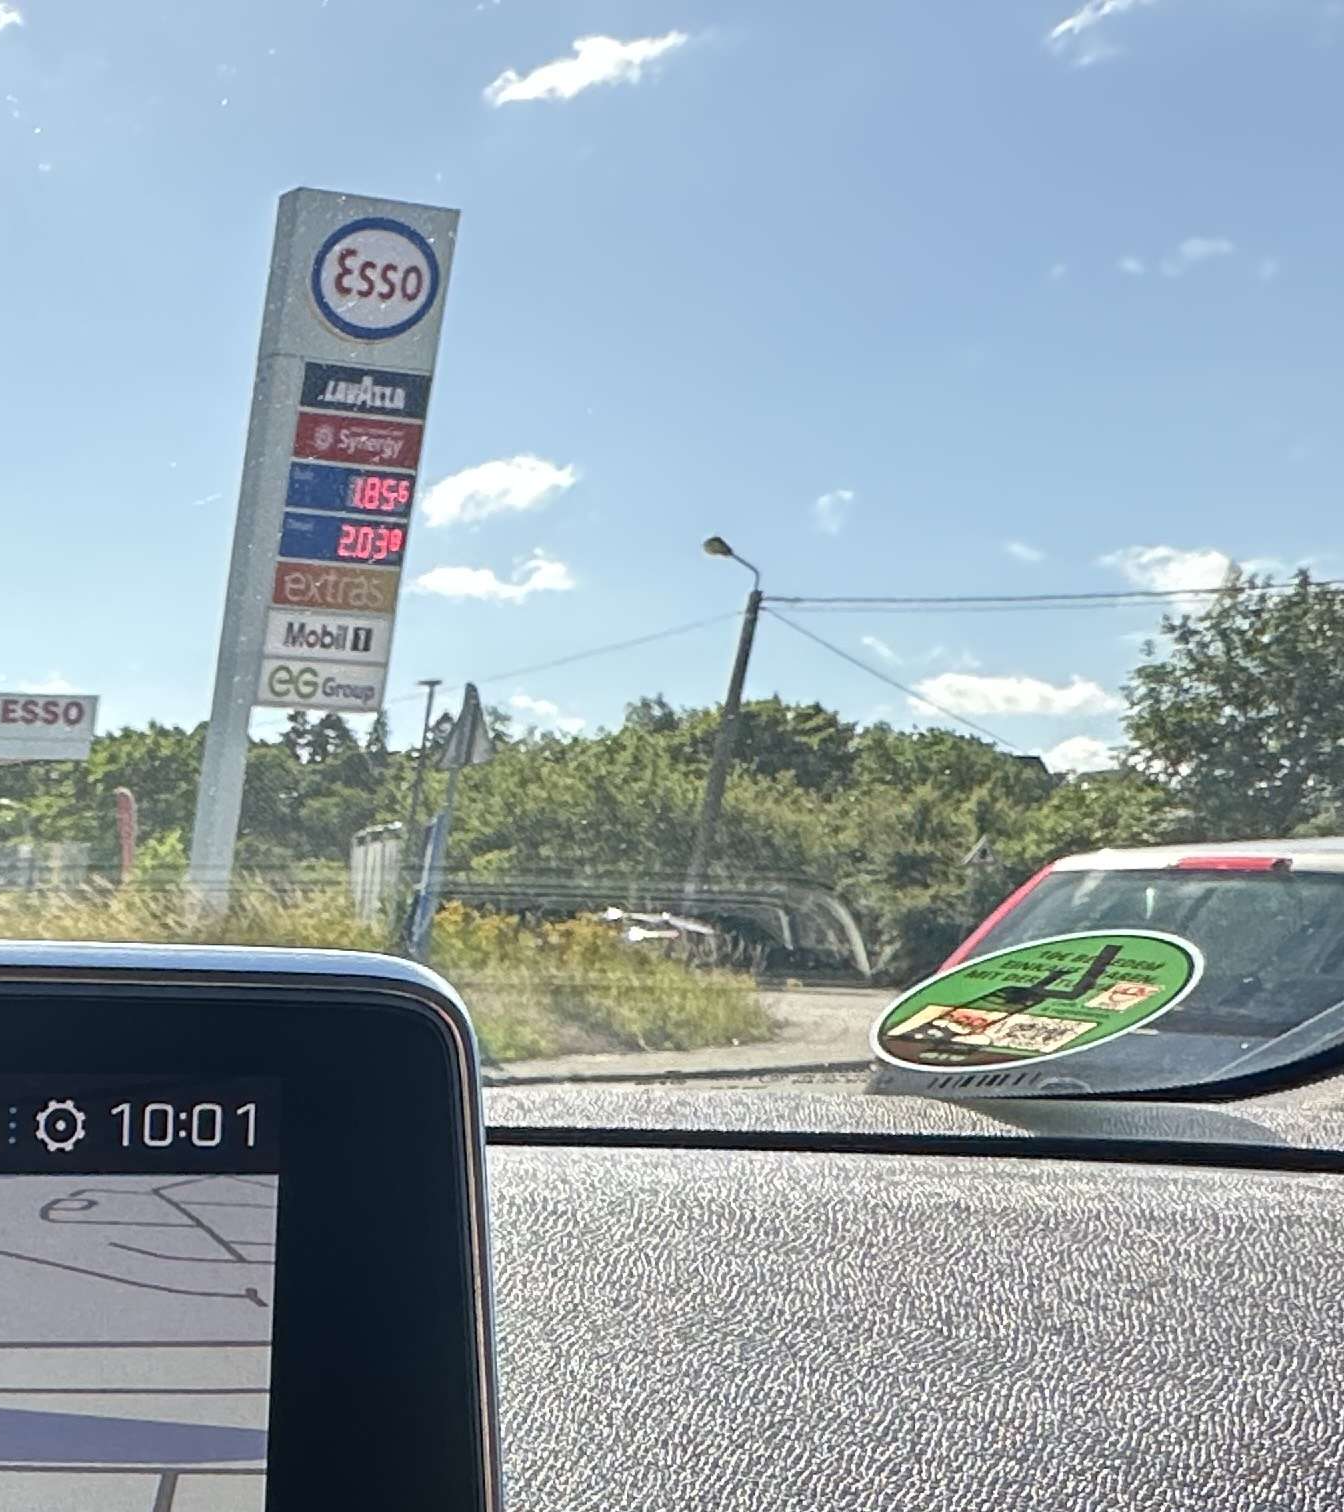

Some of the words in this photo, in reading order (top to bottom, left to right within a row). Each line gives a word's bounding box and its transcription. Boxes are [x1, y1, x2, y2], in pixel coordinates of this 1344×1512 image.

[337, 428, 404, 459] Synergy
[284, 570, 386, 606] extras
[283, 621, 348, 650] Mobil
[352, 626, 373, 652] 1
[322, 676, 375, 707] Group
[1, 699, 85, 726] ESSO
[110, 1102, 258, 1148] 10:01
